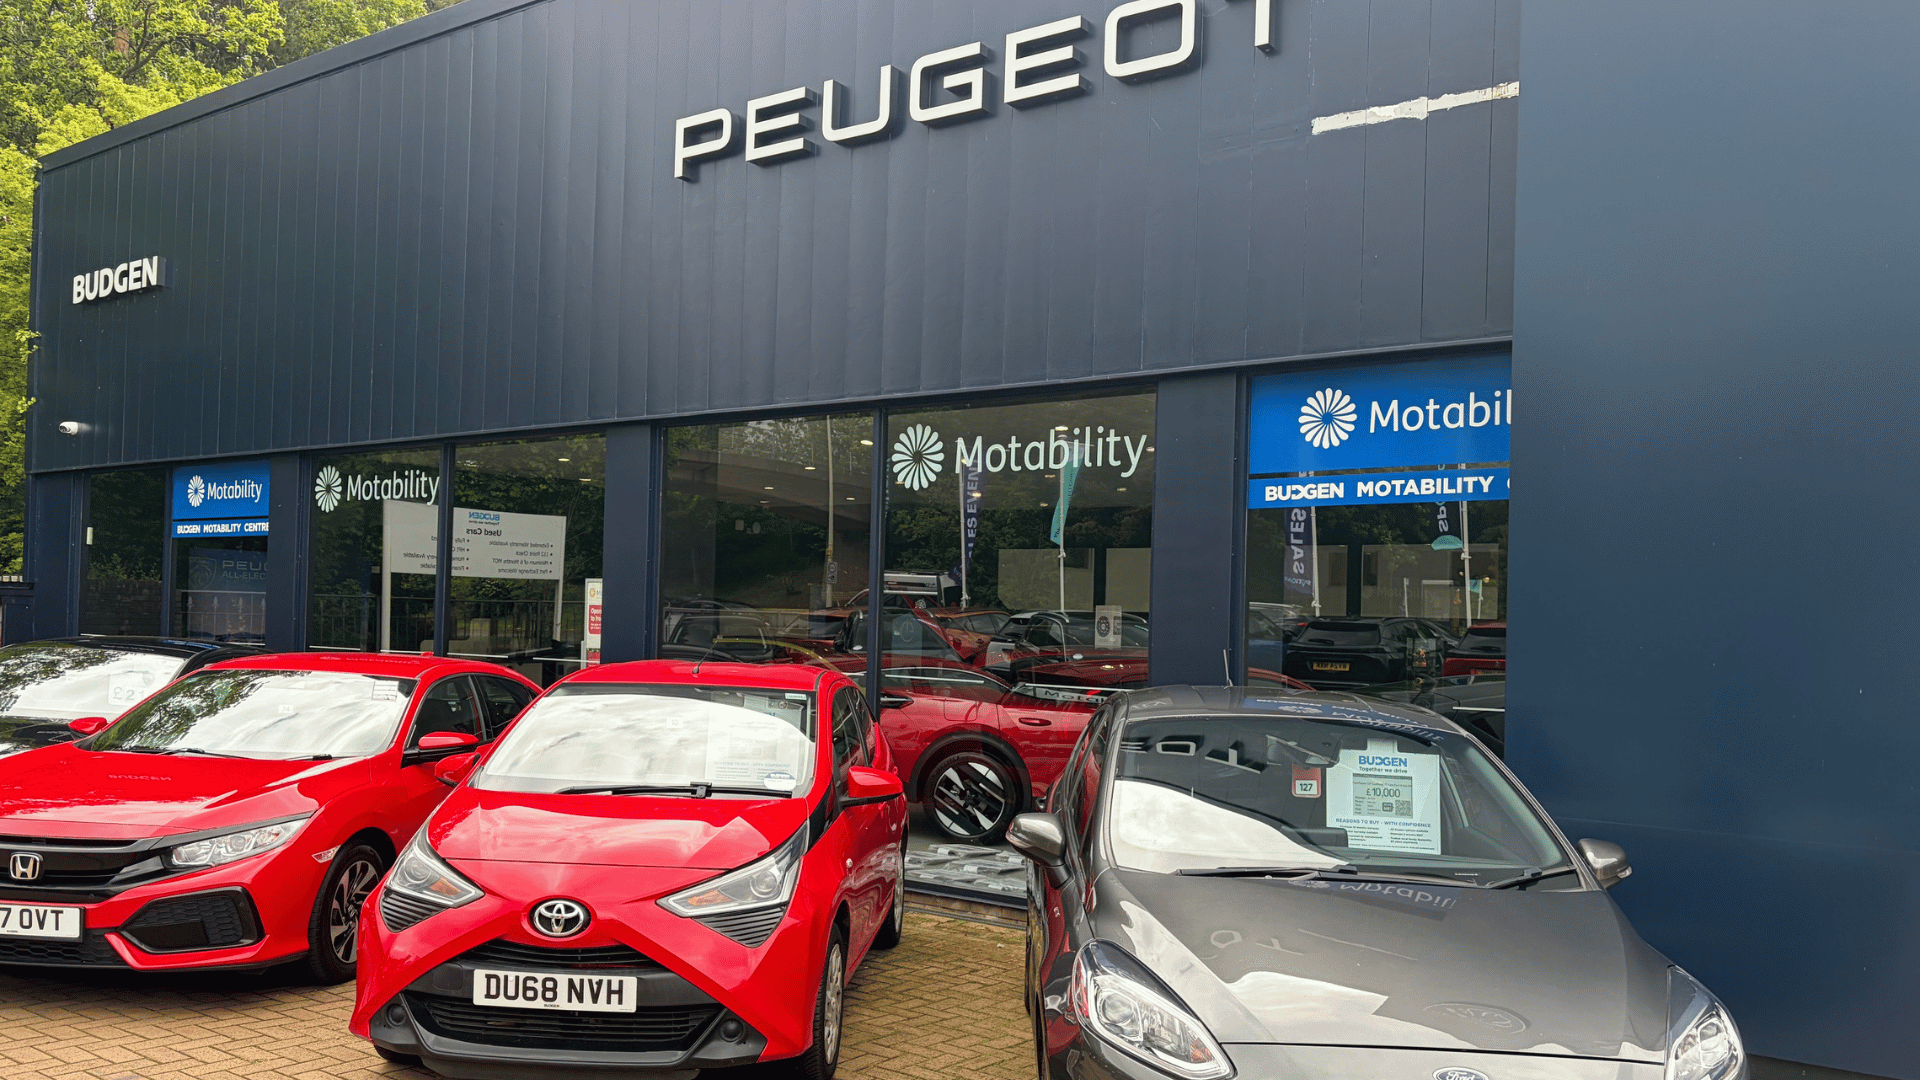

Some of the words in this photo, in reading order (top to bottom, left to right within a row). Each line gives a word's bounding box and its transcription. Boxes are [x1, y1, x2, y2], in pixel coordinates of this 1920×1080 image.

[72, 255, 158, 304] BUDGEN
[955, 426, 1147, 478] Motability
[207, 479, 263, 503] Motability
[347, 469, 440, 506] Motability
[1264, 482, 1344, 502] BUDGEN
[1357, 476, 1494, 498] MOTABILITY
[177, 525, 201, 534] BUDGEN
[203, 522, 241, 533] MOTABILITY
[244, 521, 269, 533] CENTRE
[1358, 755, 1408, 767] BUDGEN
[1299, 783, 1313, 792] 127
[1366, 787, 1401, 798] £10,000
[20, 908, 64, 931] OVT
[484, 973, 558, 1002] DU68
[567, 977, 624, 1005] NVH
